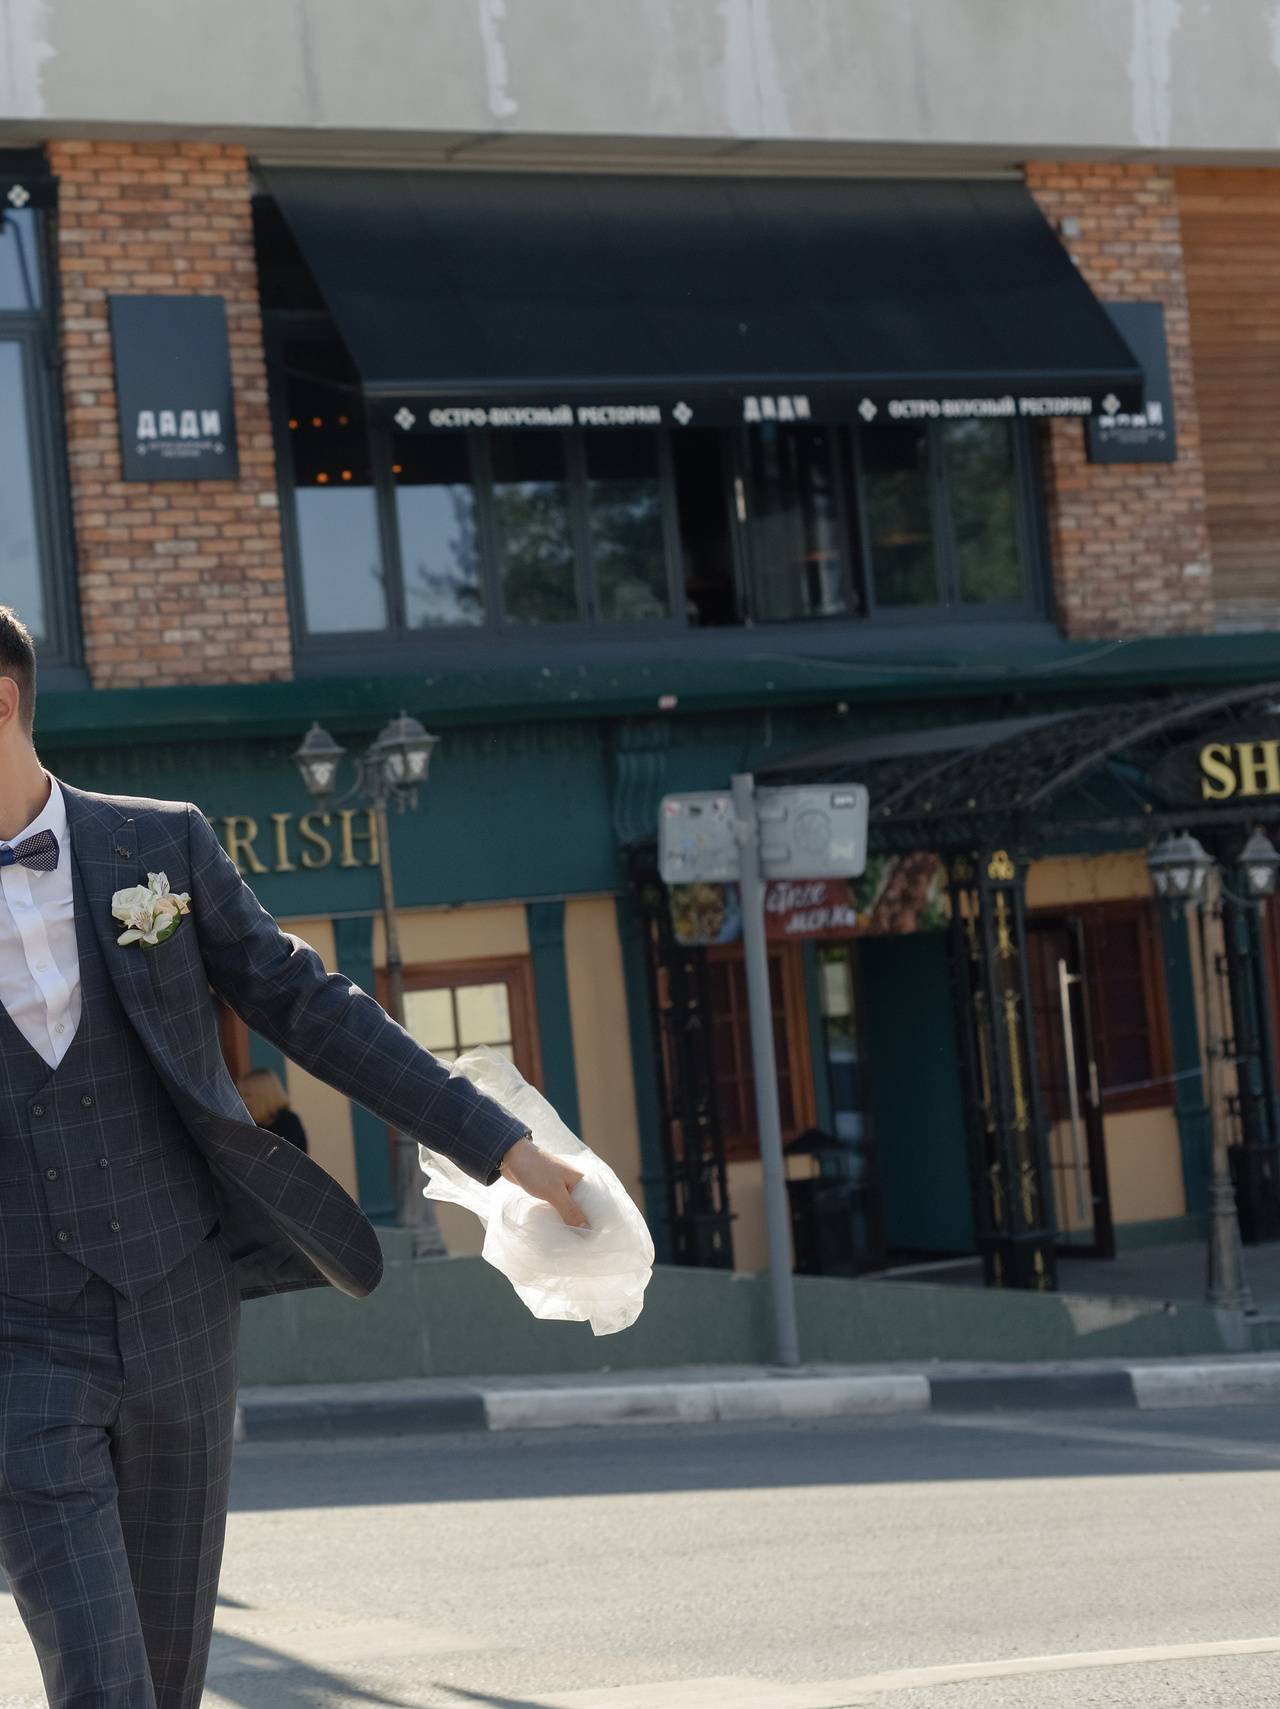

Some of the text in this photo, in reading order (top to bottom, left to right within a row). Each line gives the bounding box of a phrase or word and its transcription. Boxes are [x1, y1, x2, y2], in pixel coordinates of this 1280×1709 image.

[428, 404, 662, 428] ОСТРО-ВКУСНЫЙ РЕСТОРАН
[888, 395, 1092, 419] ОСТРО-ВКУСНЫЙ РЕСТОРАН
[1200, 740, 1280, 800] SH
[207, 808, 380, 875] RISH
